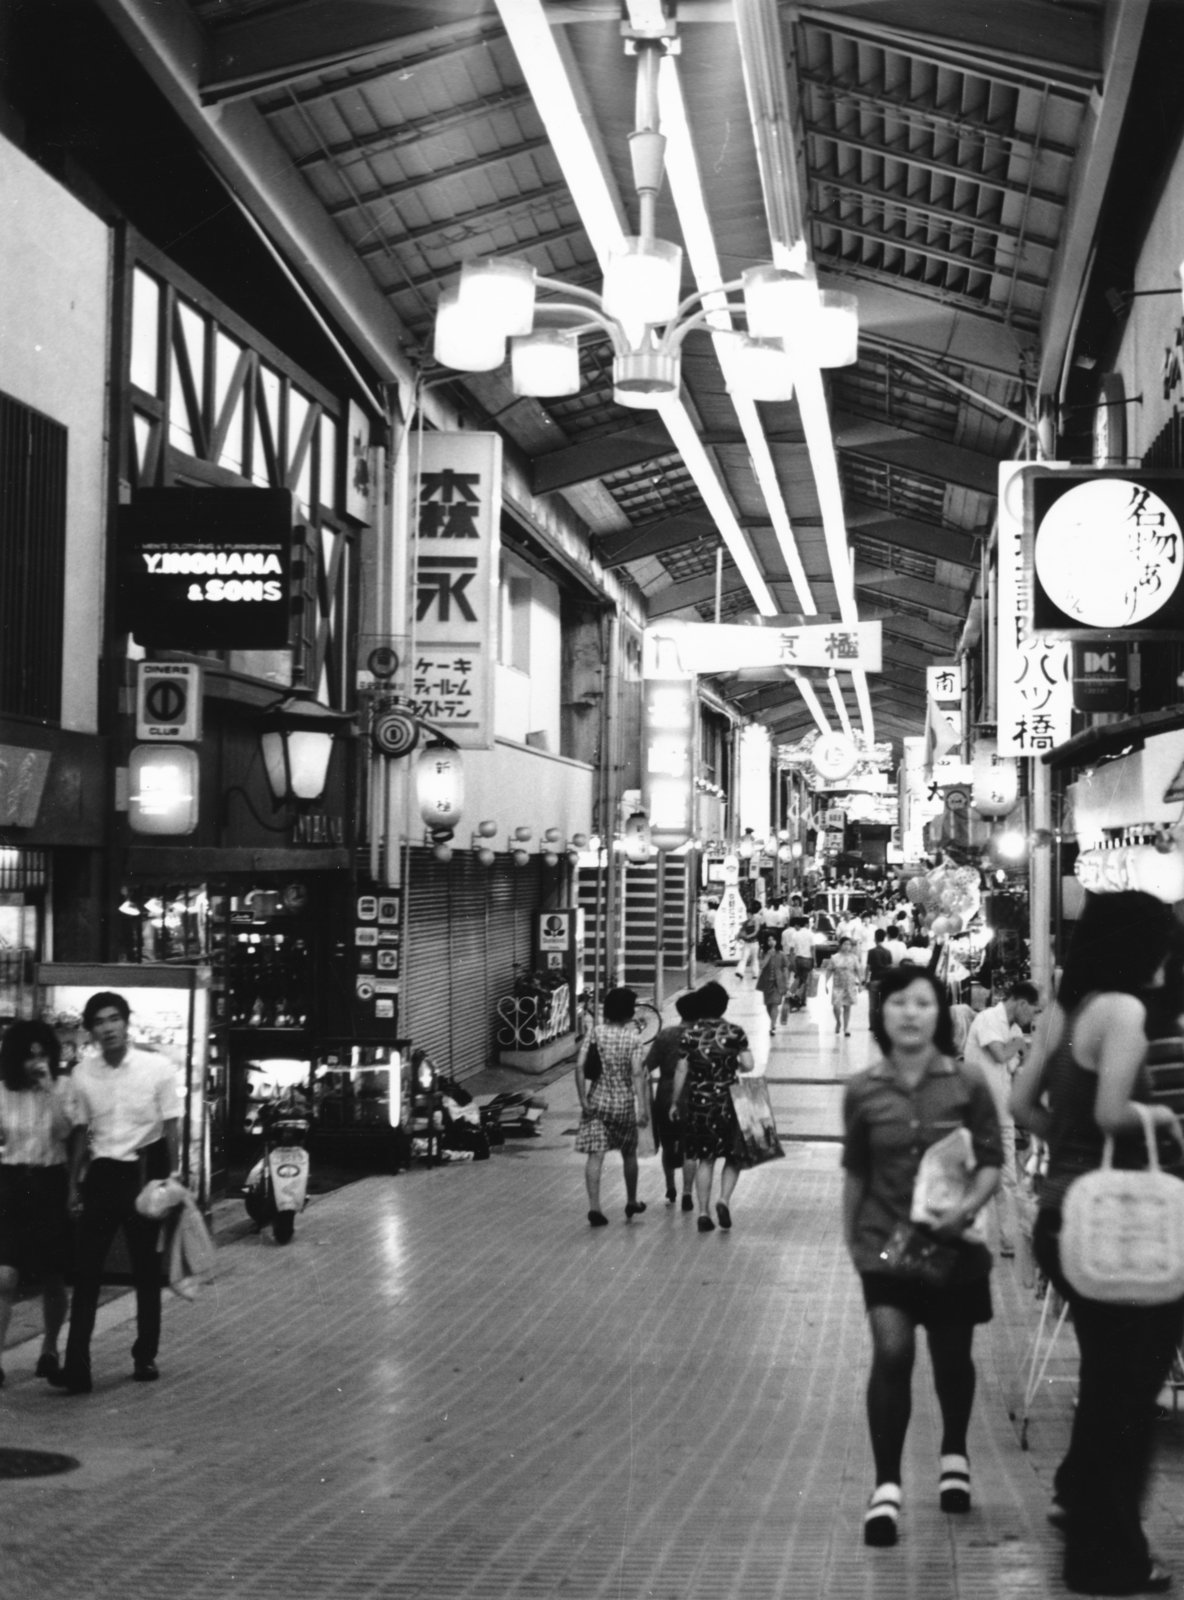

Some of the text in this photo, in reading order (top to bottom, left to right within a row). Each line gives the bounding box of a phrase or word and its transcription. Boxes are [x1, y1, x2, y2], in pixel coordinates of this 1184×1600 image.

[415, 468, 481, 623] 森永
[144, 665, 190, 675] DINERS
[414, 657, 472, 675] ケーキ
[414, 678, 472, 696] ティールーム
[149, 727, 180, 736] CLUB
